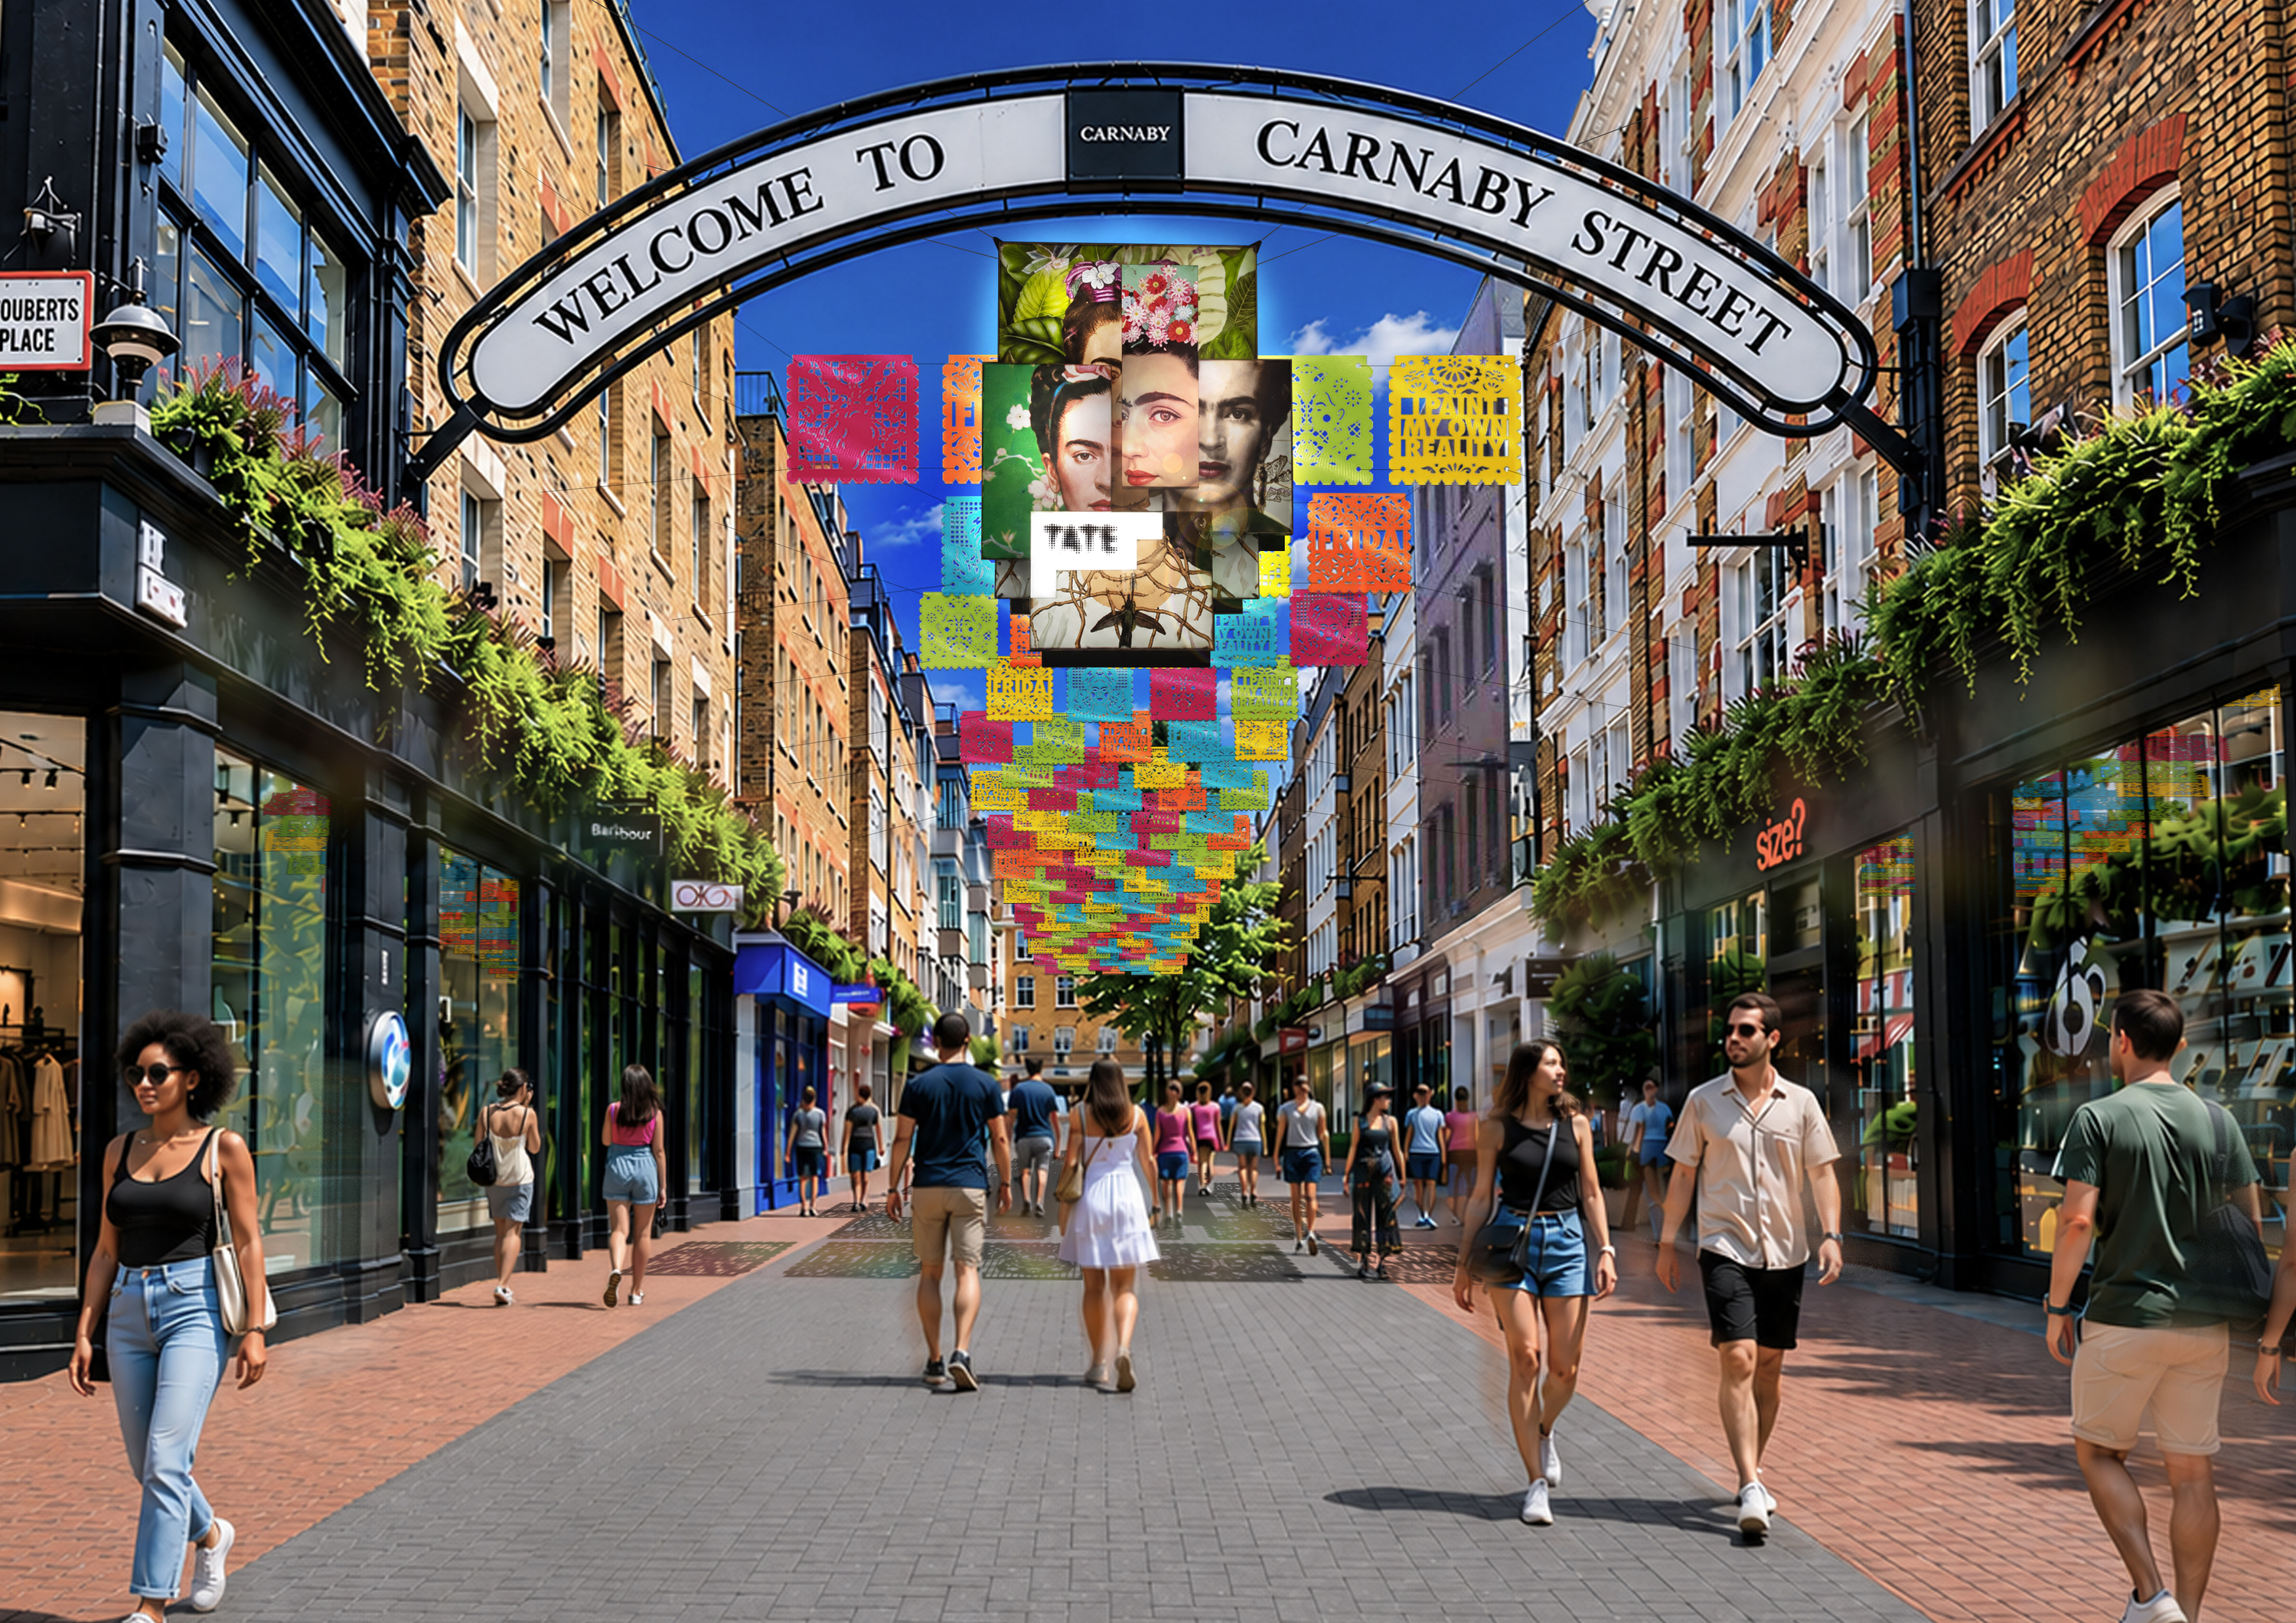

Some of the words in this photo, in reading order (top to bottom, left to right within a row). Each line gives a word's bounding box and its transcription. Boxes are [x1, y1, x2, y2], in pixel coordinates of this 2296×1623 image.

[1080, 125, 1171, 142] CARNABY
[532, 167, 824, 345] WELCOME
[856, 134, 945, 193] TO
[1255, 119, 1556, 230] CARNABY
[1570, 210, 1793, 358] STREET
[0, 298, 79, 321] OUBERTS
[0, 328, 54, 352] PLACE
[1413, 397, 1420, 415] I
[1425, 397, 1498, 415] PAINT
[1403, 419, 1441, 436] MY
[1447, 419, 1507, 436] OWN
[1405, 439, 1505, 457] REALITY
[1043, 523, 1117, 555] TATE
[1318, 530, 1401, 549] FRIDA
[1220, 615, 1264, 626] PAINT
[1233, 628, 1268, 639] OWN
[993, 680, 1046, 693] FRIDA
[1250, 676, 1287, 686] PAINT
[1261, 687, 1290, 696] OWN
[1240, 697, 1290, 706] REALITY
[1173, 730, 1216, 740] FRIDA
[1756, 797, 1805, 872] size?
